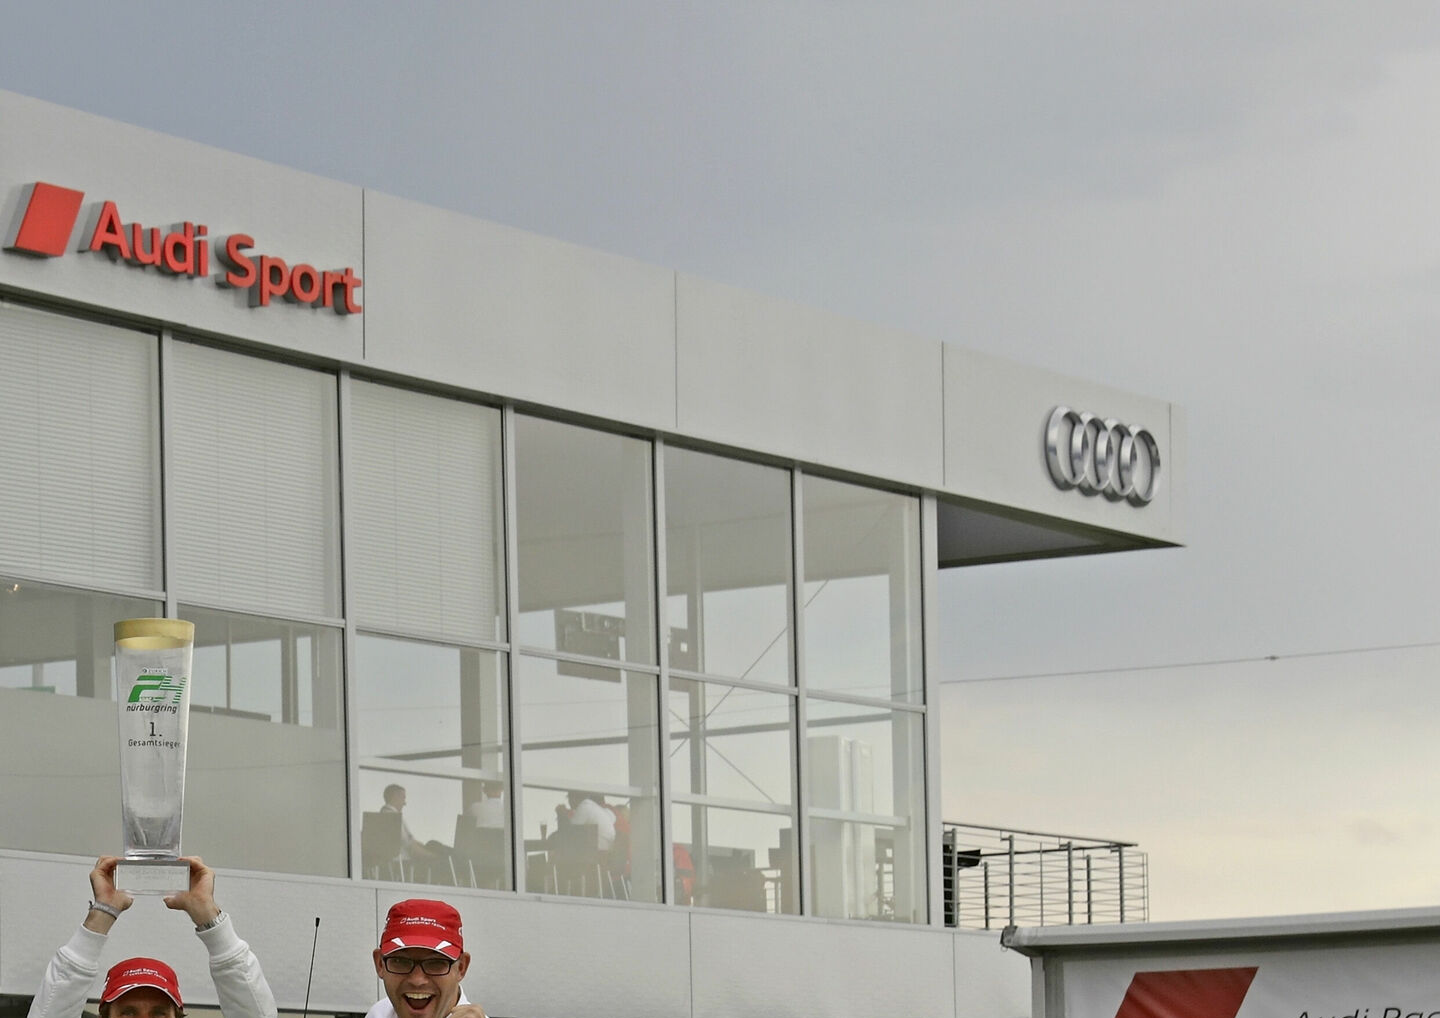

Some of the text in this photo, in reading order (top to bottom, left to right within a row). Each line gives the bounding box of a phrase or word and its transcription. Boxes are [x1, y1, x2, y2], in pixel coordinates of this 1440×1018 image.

[88, 200, 362, 314] Audi Sport
[126, 703, 178, 715] nürburgring
[149, 721, 163, 737] 1.
